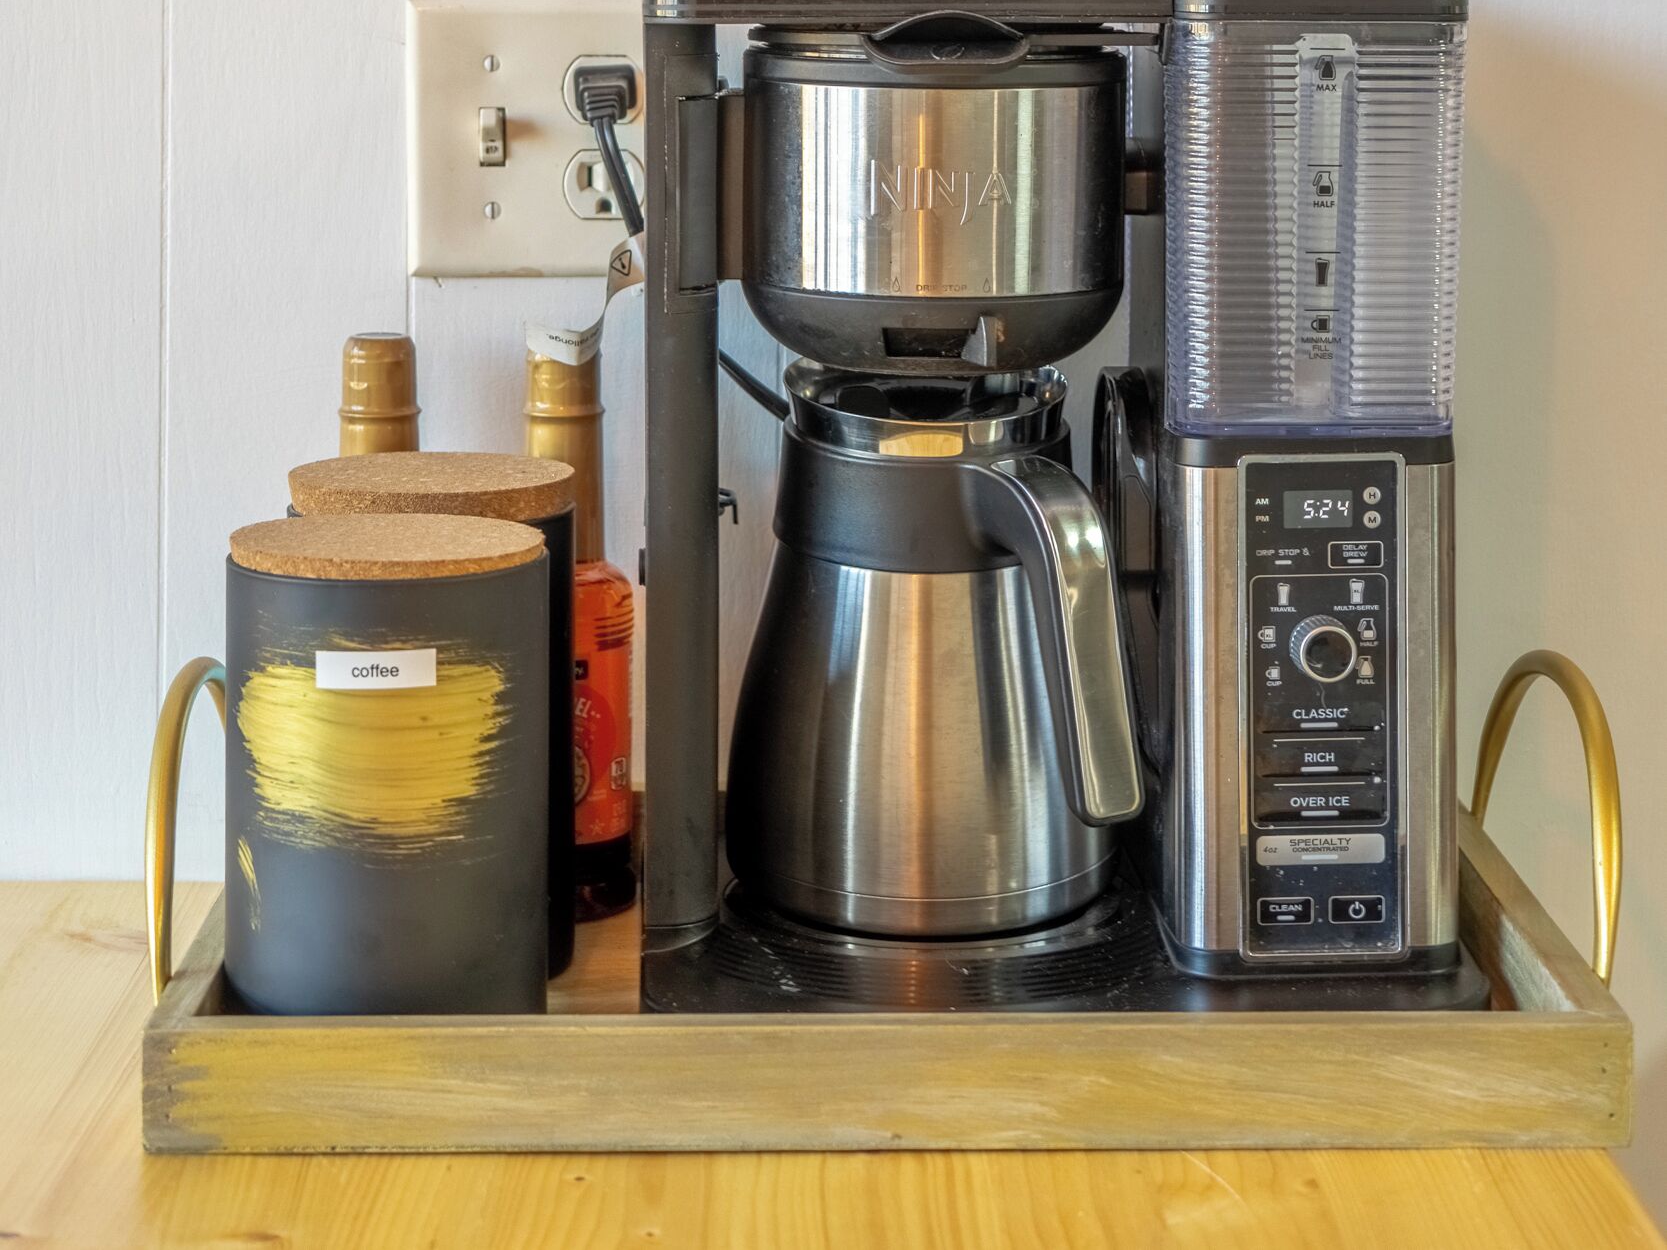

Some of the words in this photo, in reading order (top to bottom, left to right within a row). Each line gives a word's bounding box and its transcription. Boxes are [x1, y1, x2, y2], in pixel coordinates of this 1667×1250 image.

[1315, 84, 1337, 92] MAX
[870, 159, 1012, 226] NINJA
[1313, 200, 1335, 208] HALF
[943, 284, 967, 292] STOP
[1308, 352, 1334, 360] LINES
[1255, 497, 1269, 505] AM
[1303, 499, 1350, 519] 5:24
[1255, 549, 1275, 557] DRIP
[351, 663, 400, 678] coffee
[1293, 708, 1347, 719] CLASSIC
[1304, 752, 1335, 762] RICH
[1290, 797, 1326, 807] OVER
[1329, 797, 1350, 807] ICE
[1289, 837, 1351, 847] SPECIALTY
